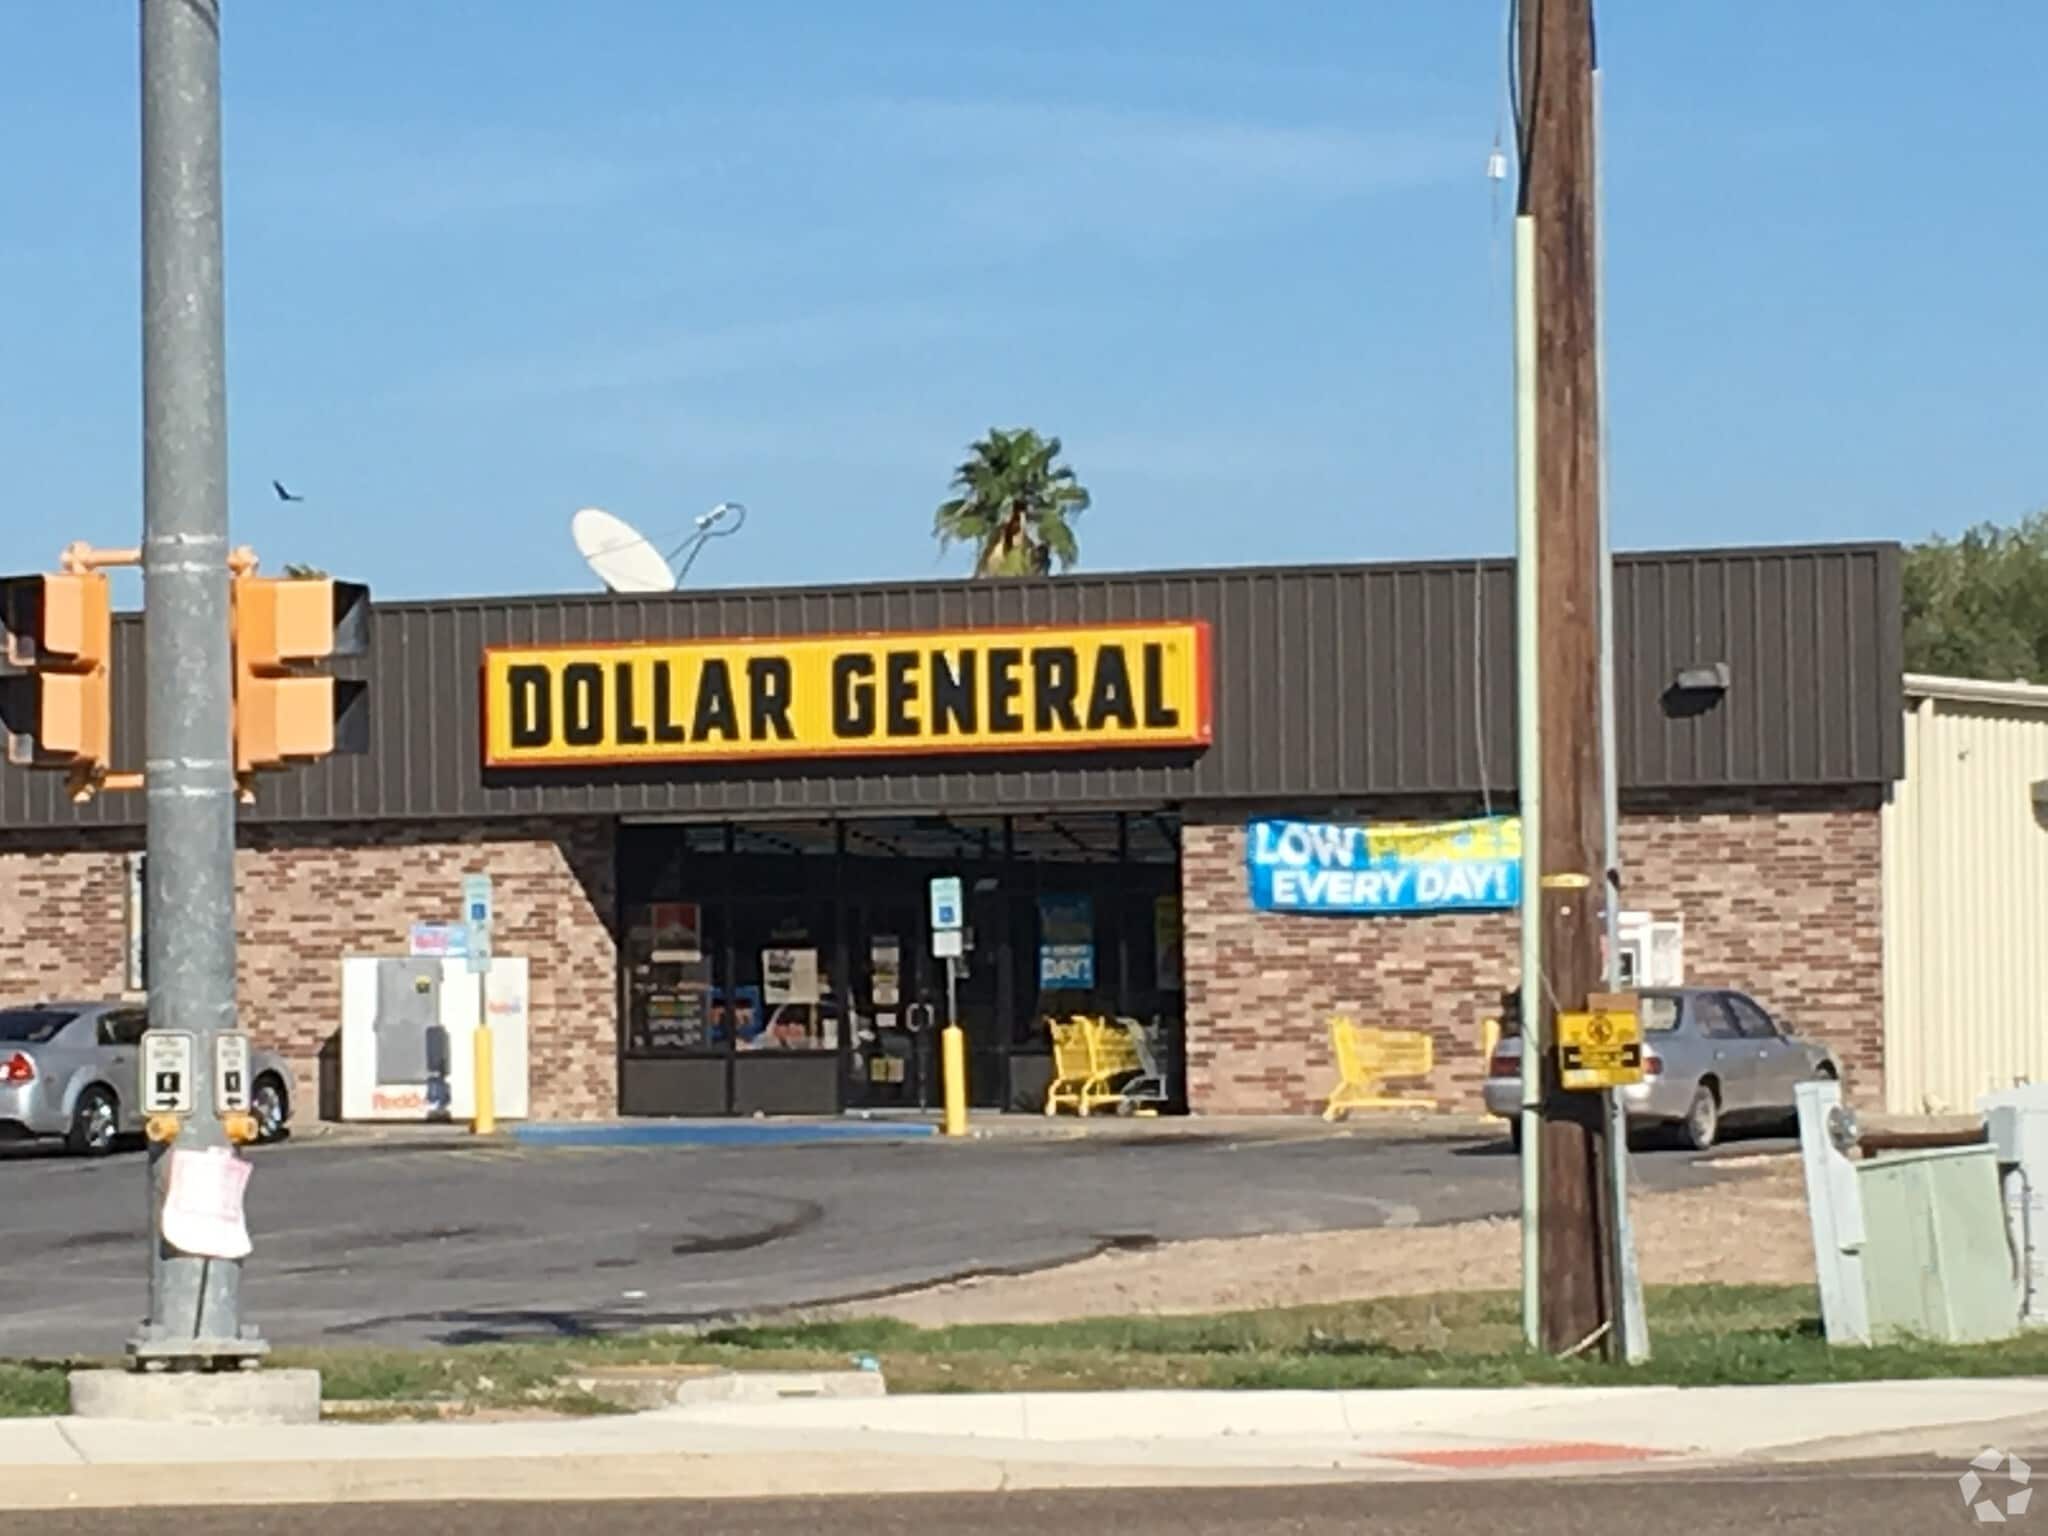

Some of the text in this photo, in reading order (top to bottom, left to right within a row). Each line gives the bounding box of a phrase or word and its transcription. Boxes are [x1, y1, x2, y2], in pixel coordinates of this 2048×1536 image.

[507, 643, 1179, 748] DOLLAR GENERAL
[1255, 821, 1360, 866] LOW
[1272, 863, 1509, 904] EVERY DAY!
